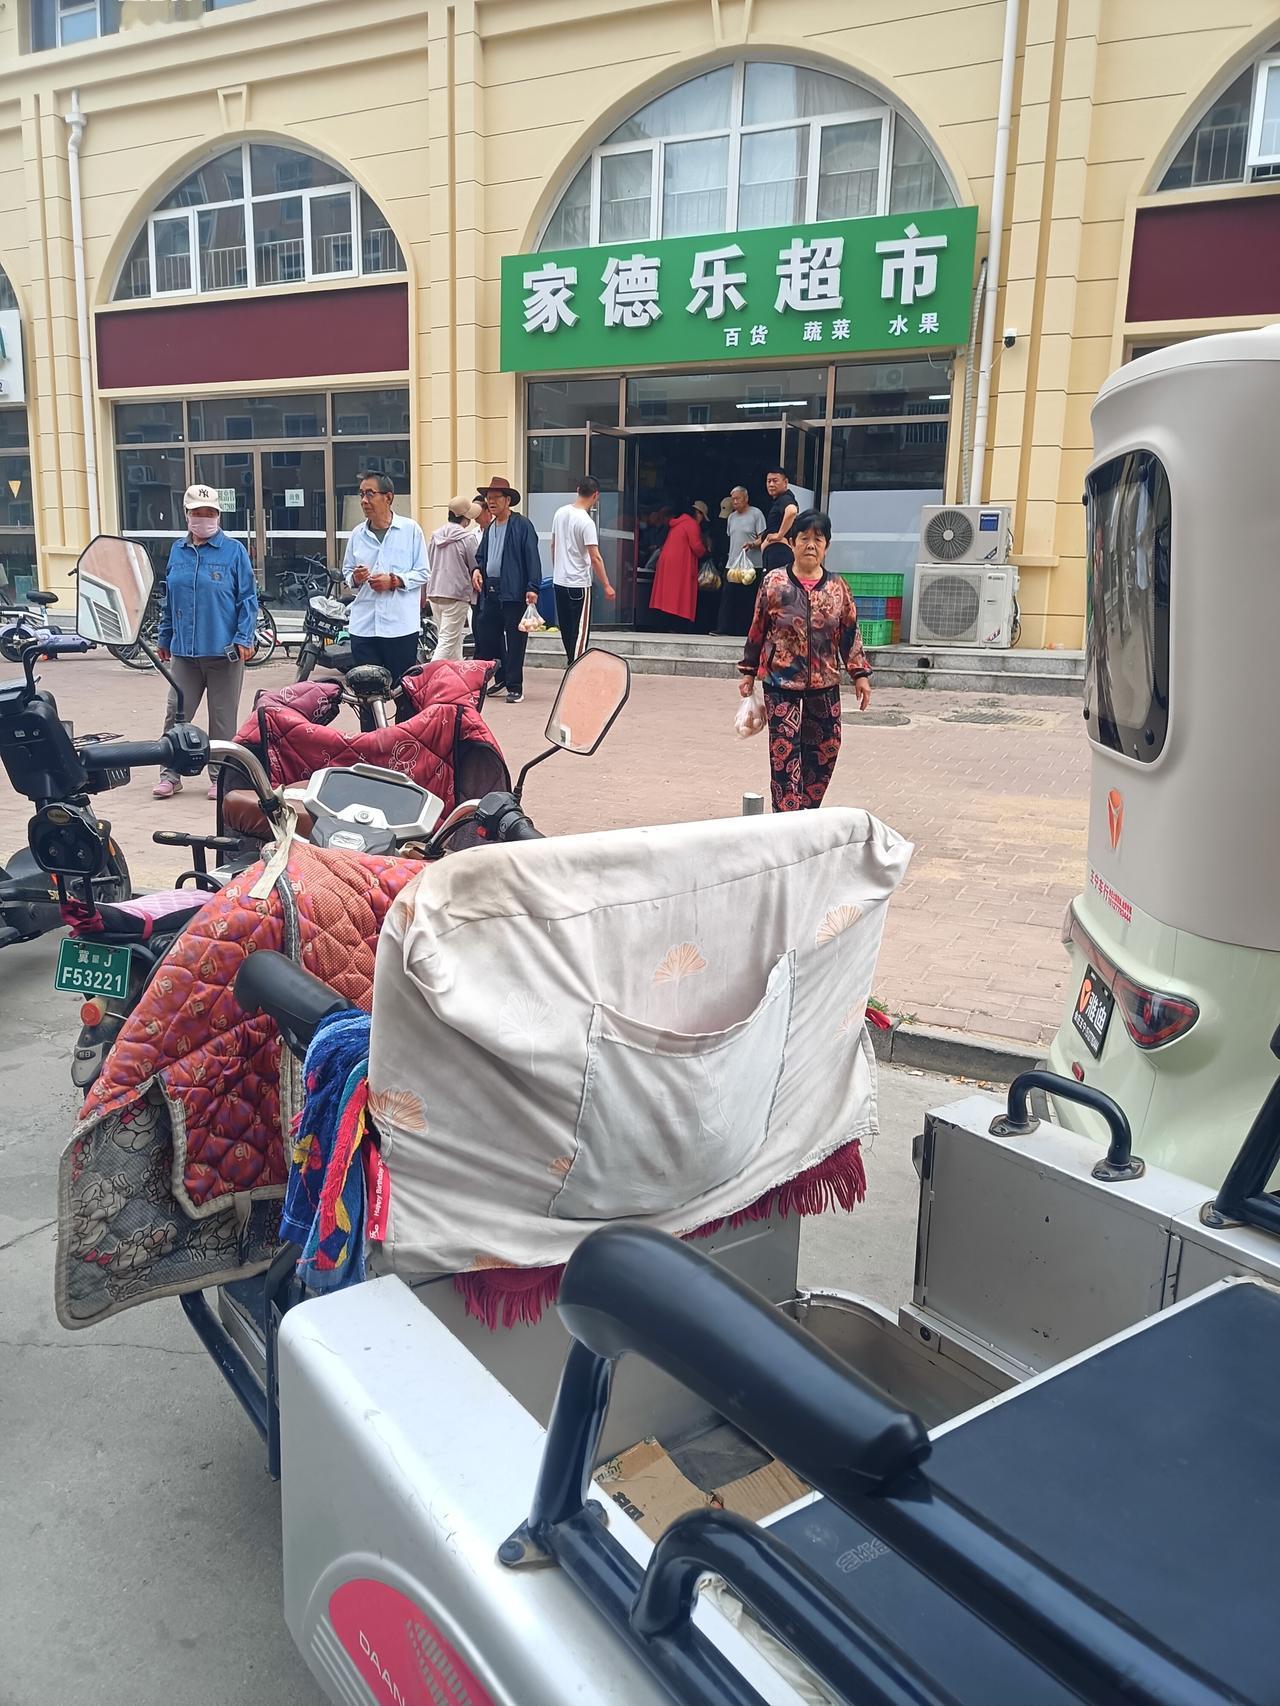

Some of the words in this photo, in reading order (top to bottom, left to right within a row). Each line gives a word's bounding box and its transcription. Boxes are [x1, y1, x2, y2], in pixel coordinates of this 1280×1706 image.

[522, 223, 948, 334] 家德乐超市
[723, 325, 769, 347] 百货
[802, 318, 851, 343] 蔬菜
[888, 312, 939, 337] 水果
[103, 954, 112, 967] J
[61, 966, 122, 992] F53221
[376, 1166, 385, 1194] Birthday
[374, 1194, 382, 1216] Happy
